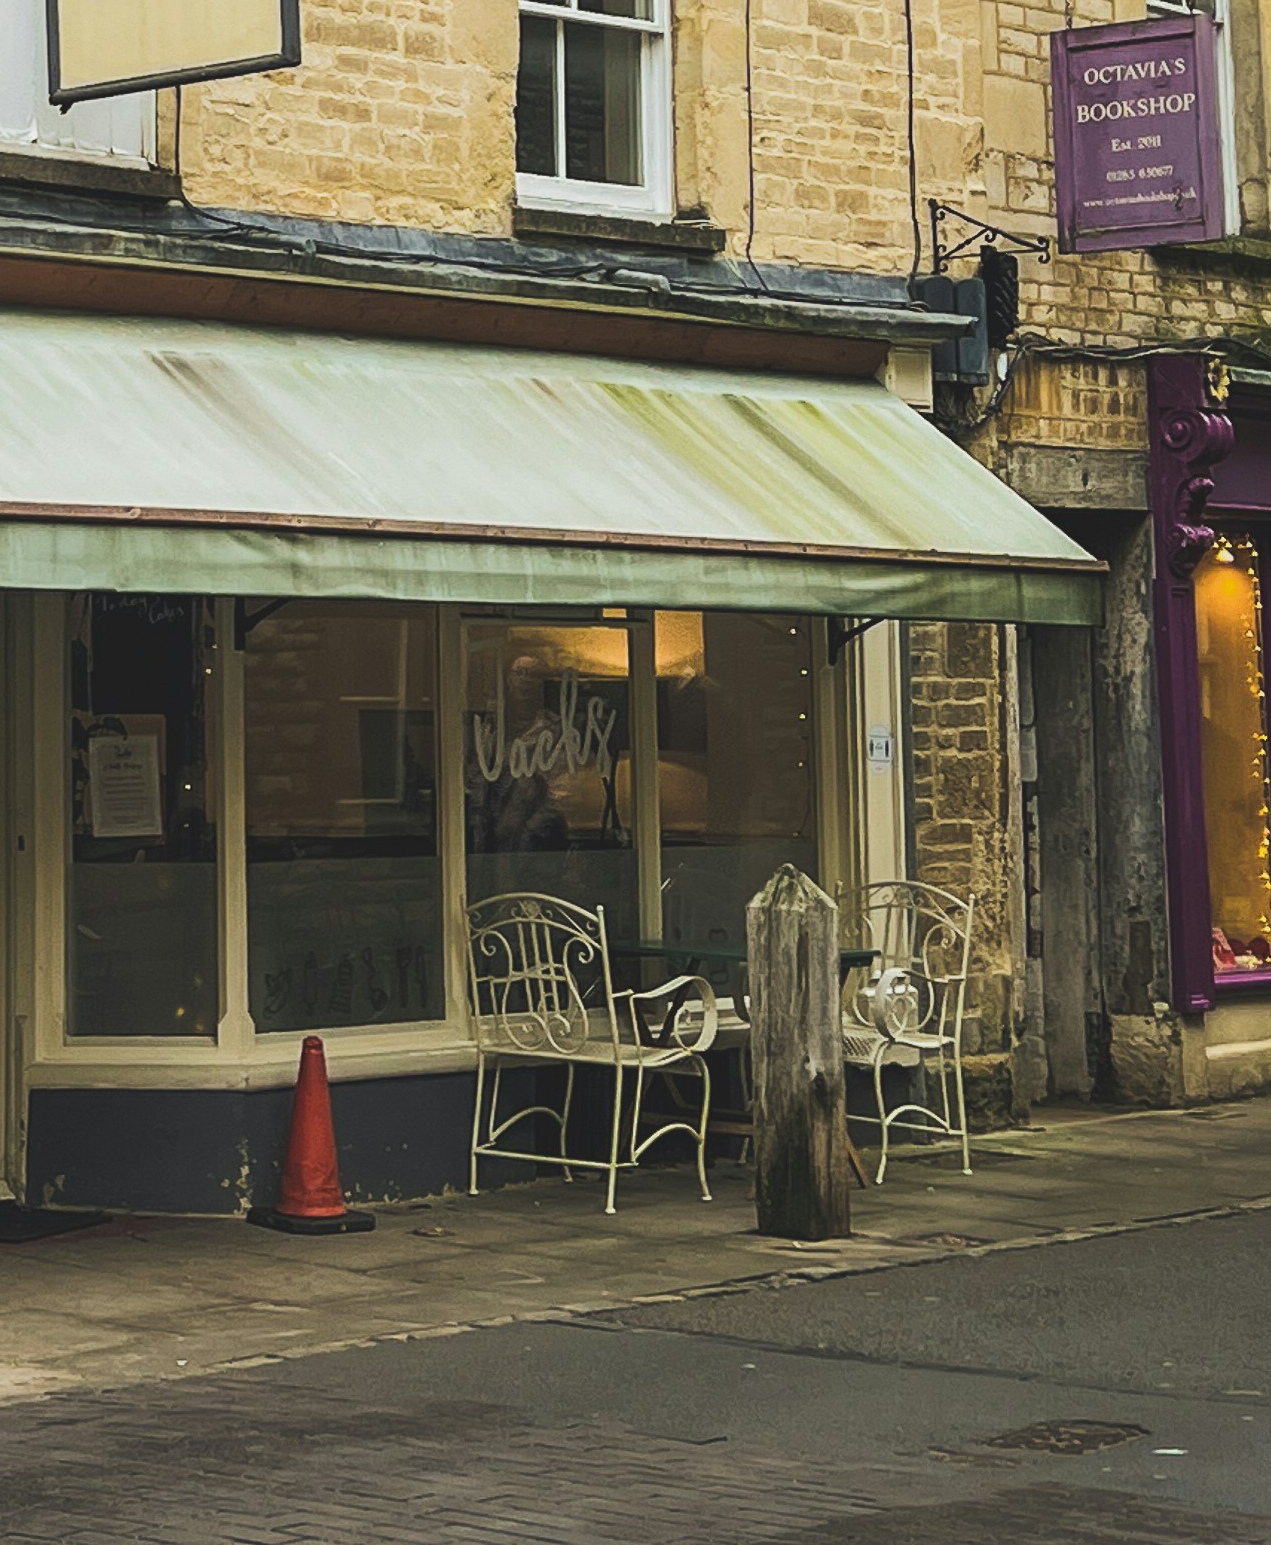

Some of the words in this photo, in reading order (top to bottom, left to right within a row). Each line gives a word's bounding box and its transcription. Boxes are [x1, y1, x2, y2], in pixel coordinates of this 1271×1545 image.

[1083, 57, 1187, 86] OCTAVIA'S
[1076, 93, 1196, 124] BOOKSHOP
[467, 636, 617, 782] Jacks
